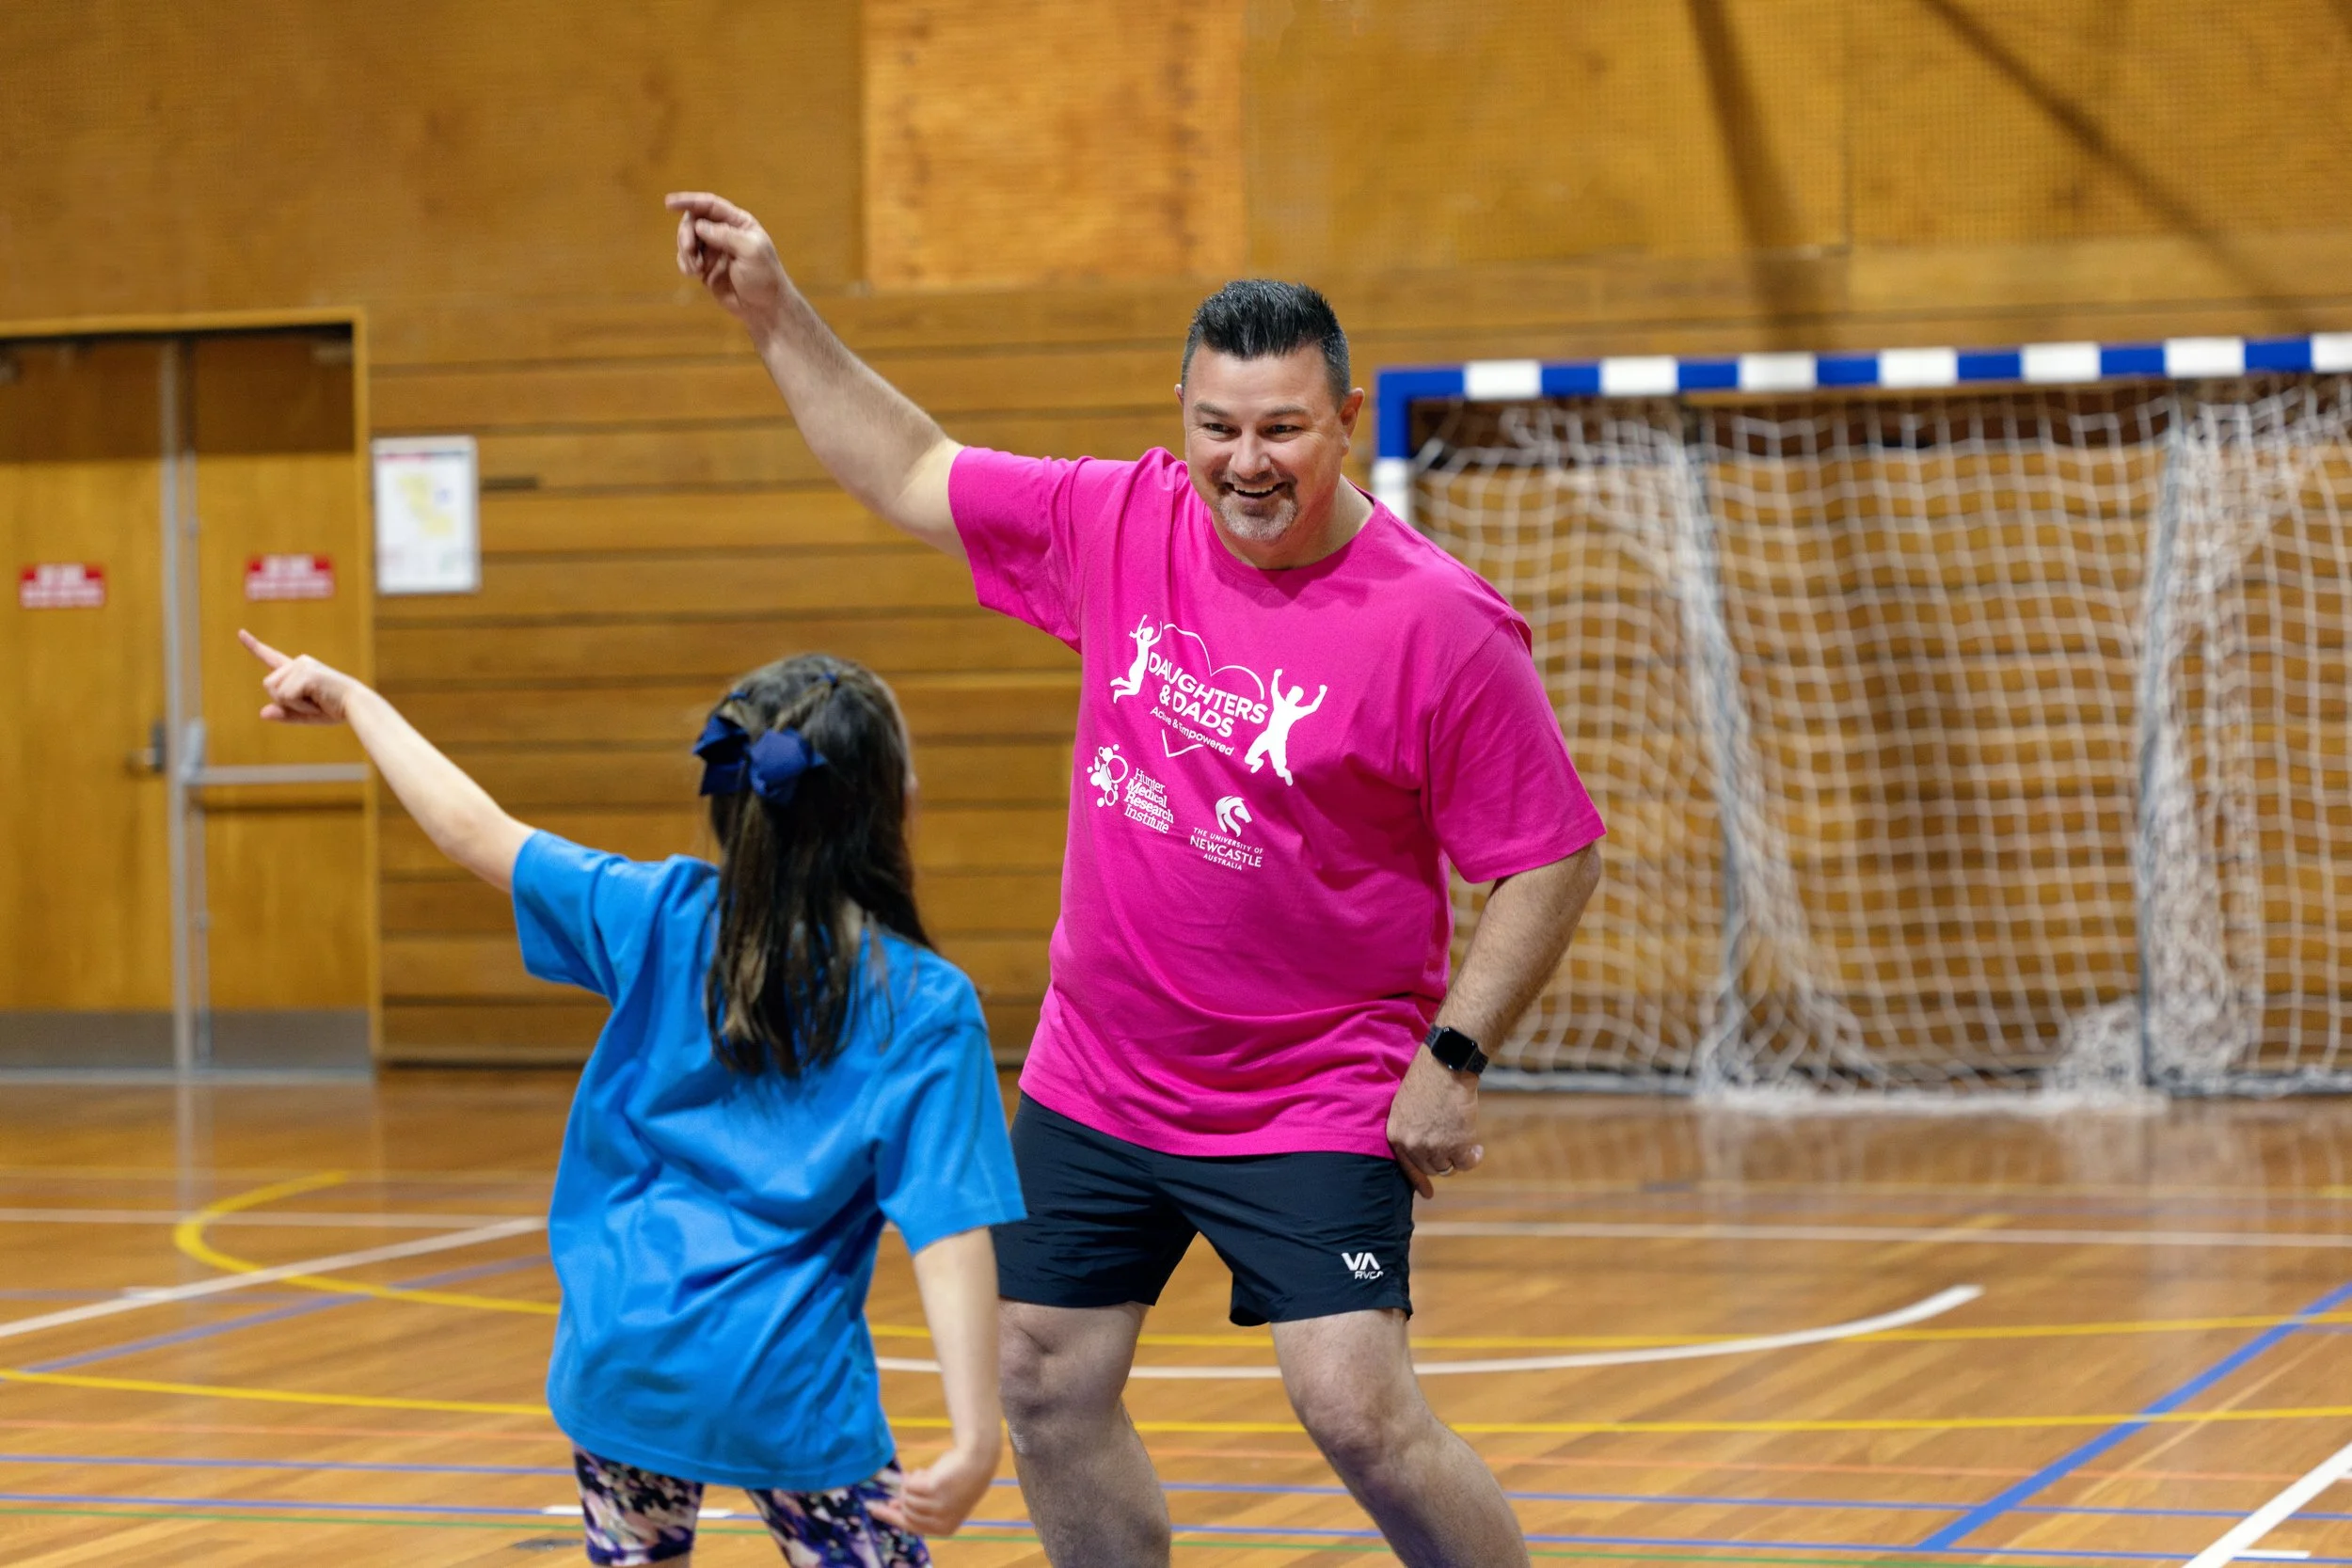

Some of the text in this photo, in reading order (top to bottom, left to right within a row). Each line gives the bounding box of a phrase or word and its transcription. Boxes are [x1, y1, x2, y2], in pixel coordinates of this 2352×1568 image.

[1148, 652, 1268, 723] DAUGHTERS
[1159, 685, 1234, 737] & DADS
[1172, 719, 1179, 729] &
[1179, 723, 1234, 756] Empowered
[1125, 779, 1168, 808] Medical
[1134, 768, 1166, 794] Hunter
[1123, 791, 1174, 824] Research
[1124, 804, 1169, 834] Institute
[1189, 835, 1263, 868] NEWCASTLE
[1193, 827, 1207, 837] THE
[1210, 832, 1251, 852] UNIVERSITY
[1203, 853, 1243, 871] AUSTRALIA
